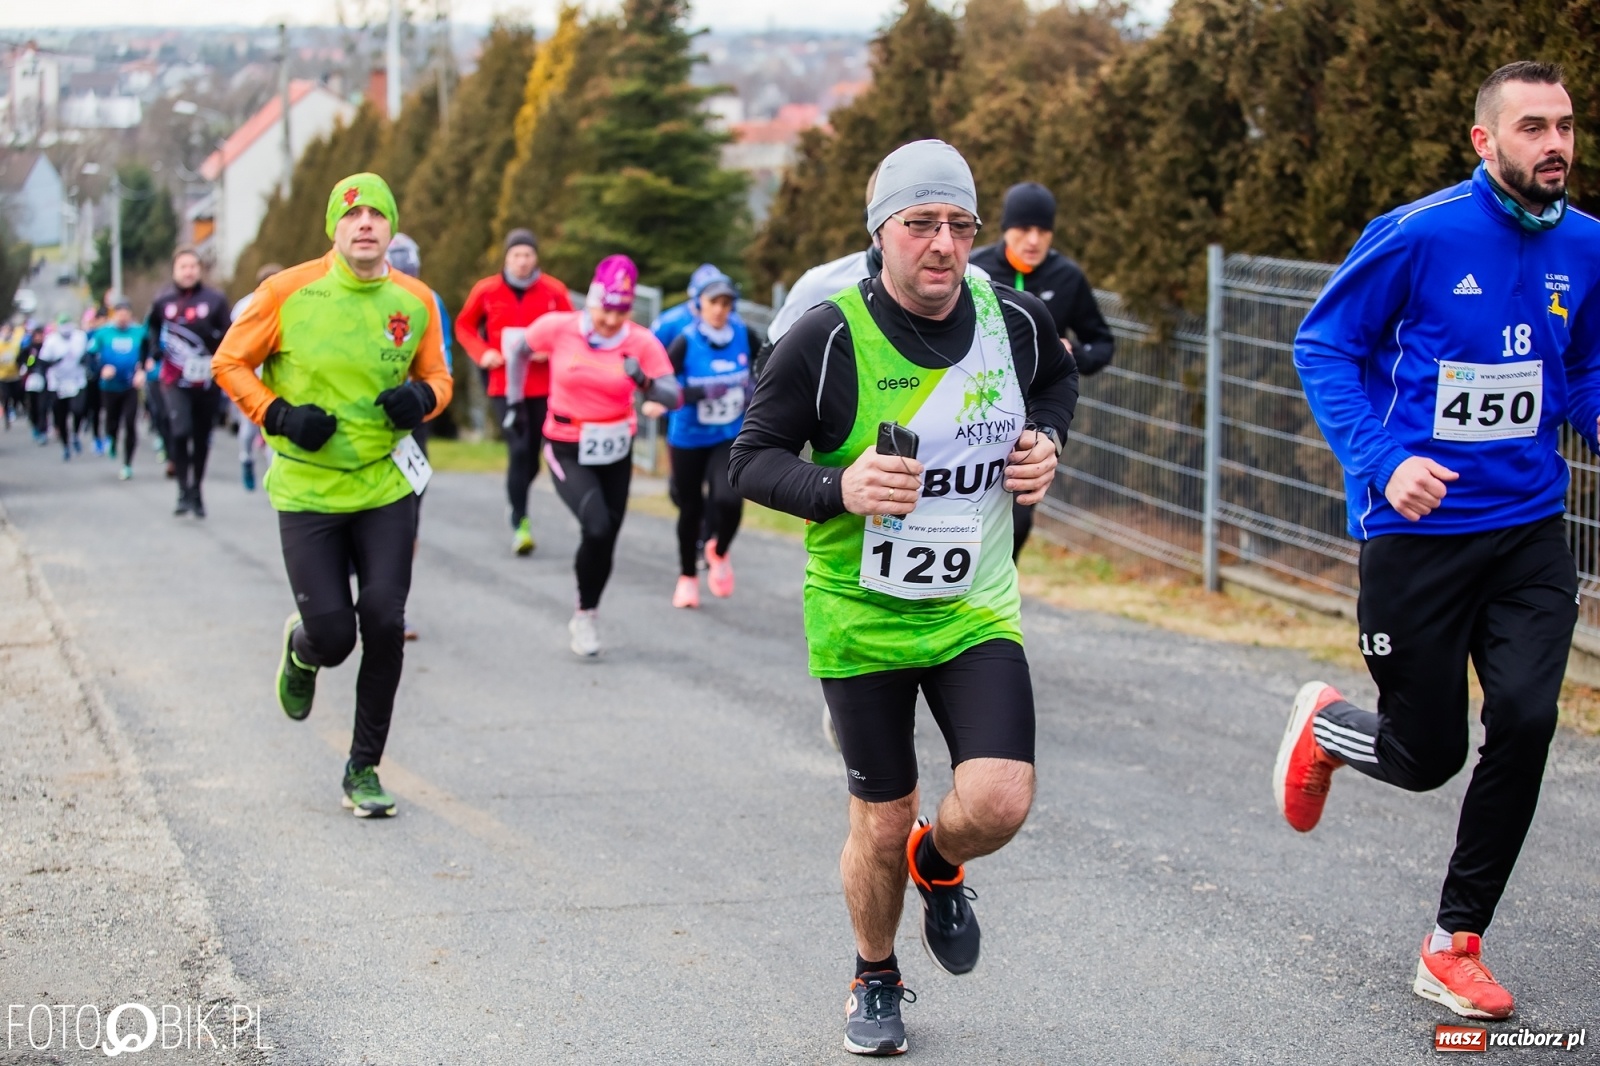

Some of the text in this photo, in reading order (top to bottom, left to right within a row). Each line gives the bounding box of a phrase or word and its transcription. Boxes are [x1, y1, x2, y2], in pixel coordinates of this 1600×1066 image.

[299, 287, 331, 298] deep
[1453, 287, 1482, 295] adidas
[1502, 323, 1532, 357] 18
[877, 376, 920, 391] deep
[1442, 391, 1535, 426] 450
[585, 435, 626, 456] 293
[968, 433, 1008, 446] LYSKI
[908, 524, 977, 534] www.personalbest.pl
[872, 540, 971, 584] 129
[1361, 632, 1392, 656] 18
